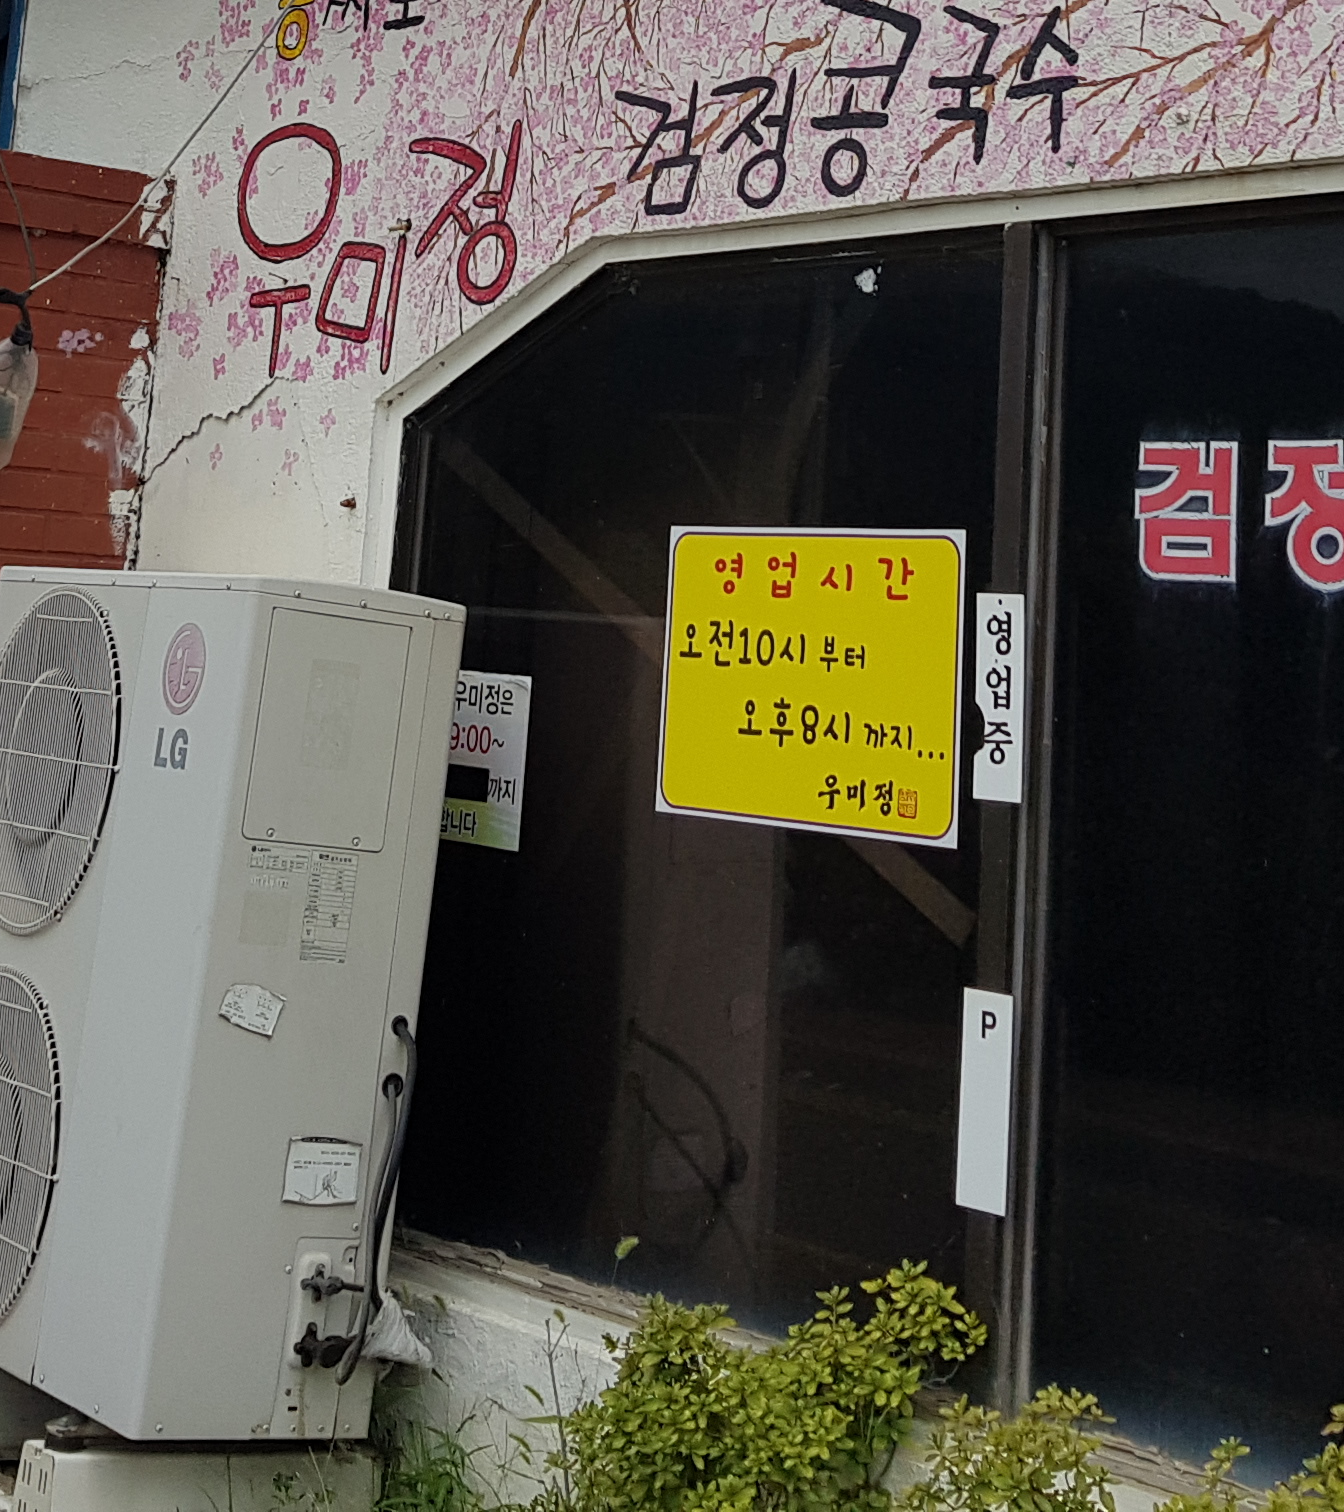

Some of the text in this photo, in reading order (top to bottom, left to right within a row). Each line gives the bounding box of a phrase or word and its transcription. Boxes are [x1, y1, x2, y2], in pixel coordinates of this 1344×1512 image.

[236, 120, 524, 378] 우미정
[678, 619, 867, 674] 오전10시 부터
[981, 610, 1014, 766] 영업중
[737, 696, 852, 749] 오후8시
[153, 727, 190, 771] LG
[486, 776, 517, 806] 까지
[817, 774, 895, 817] 우미정
[979, 1011, 998, 1040] P
